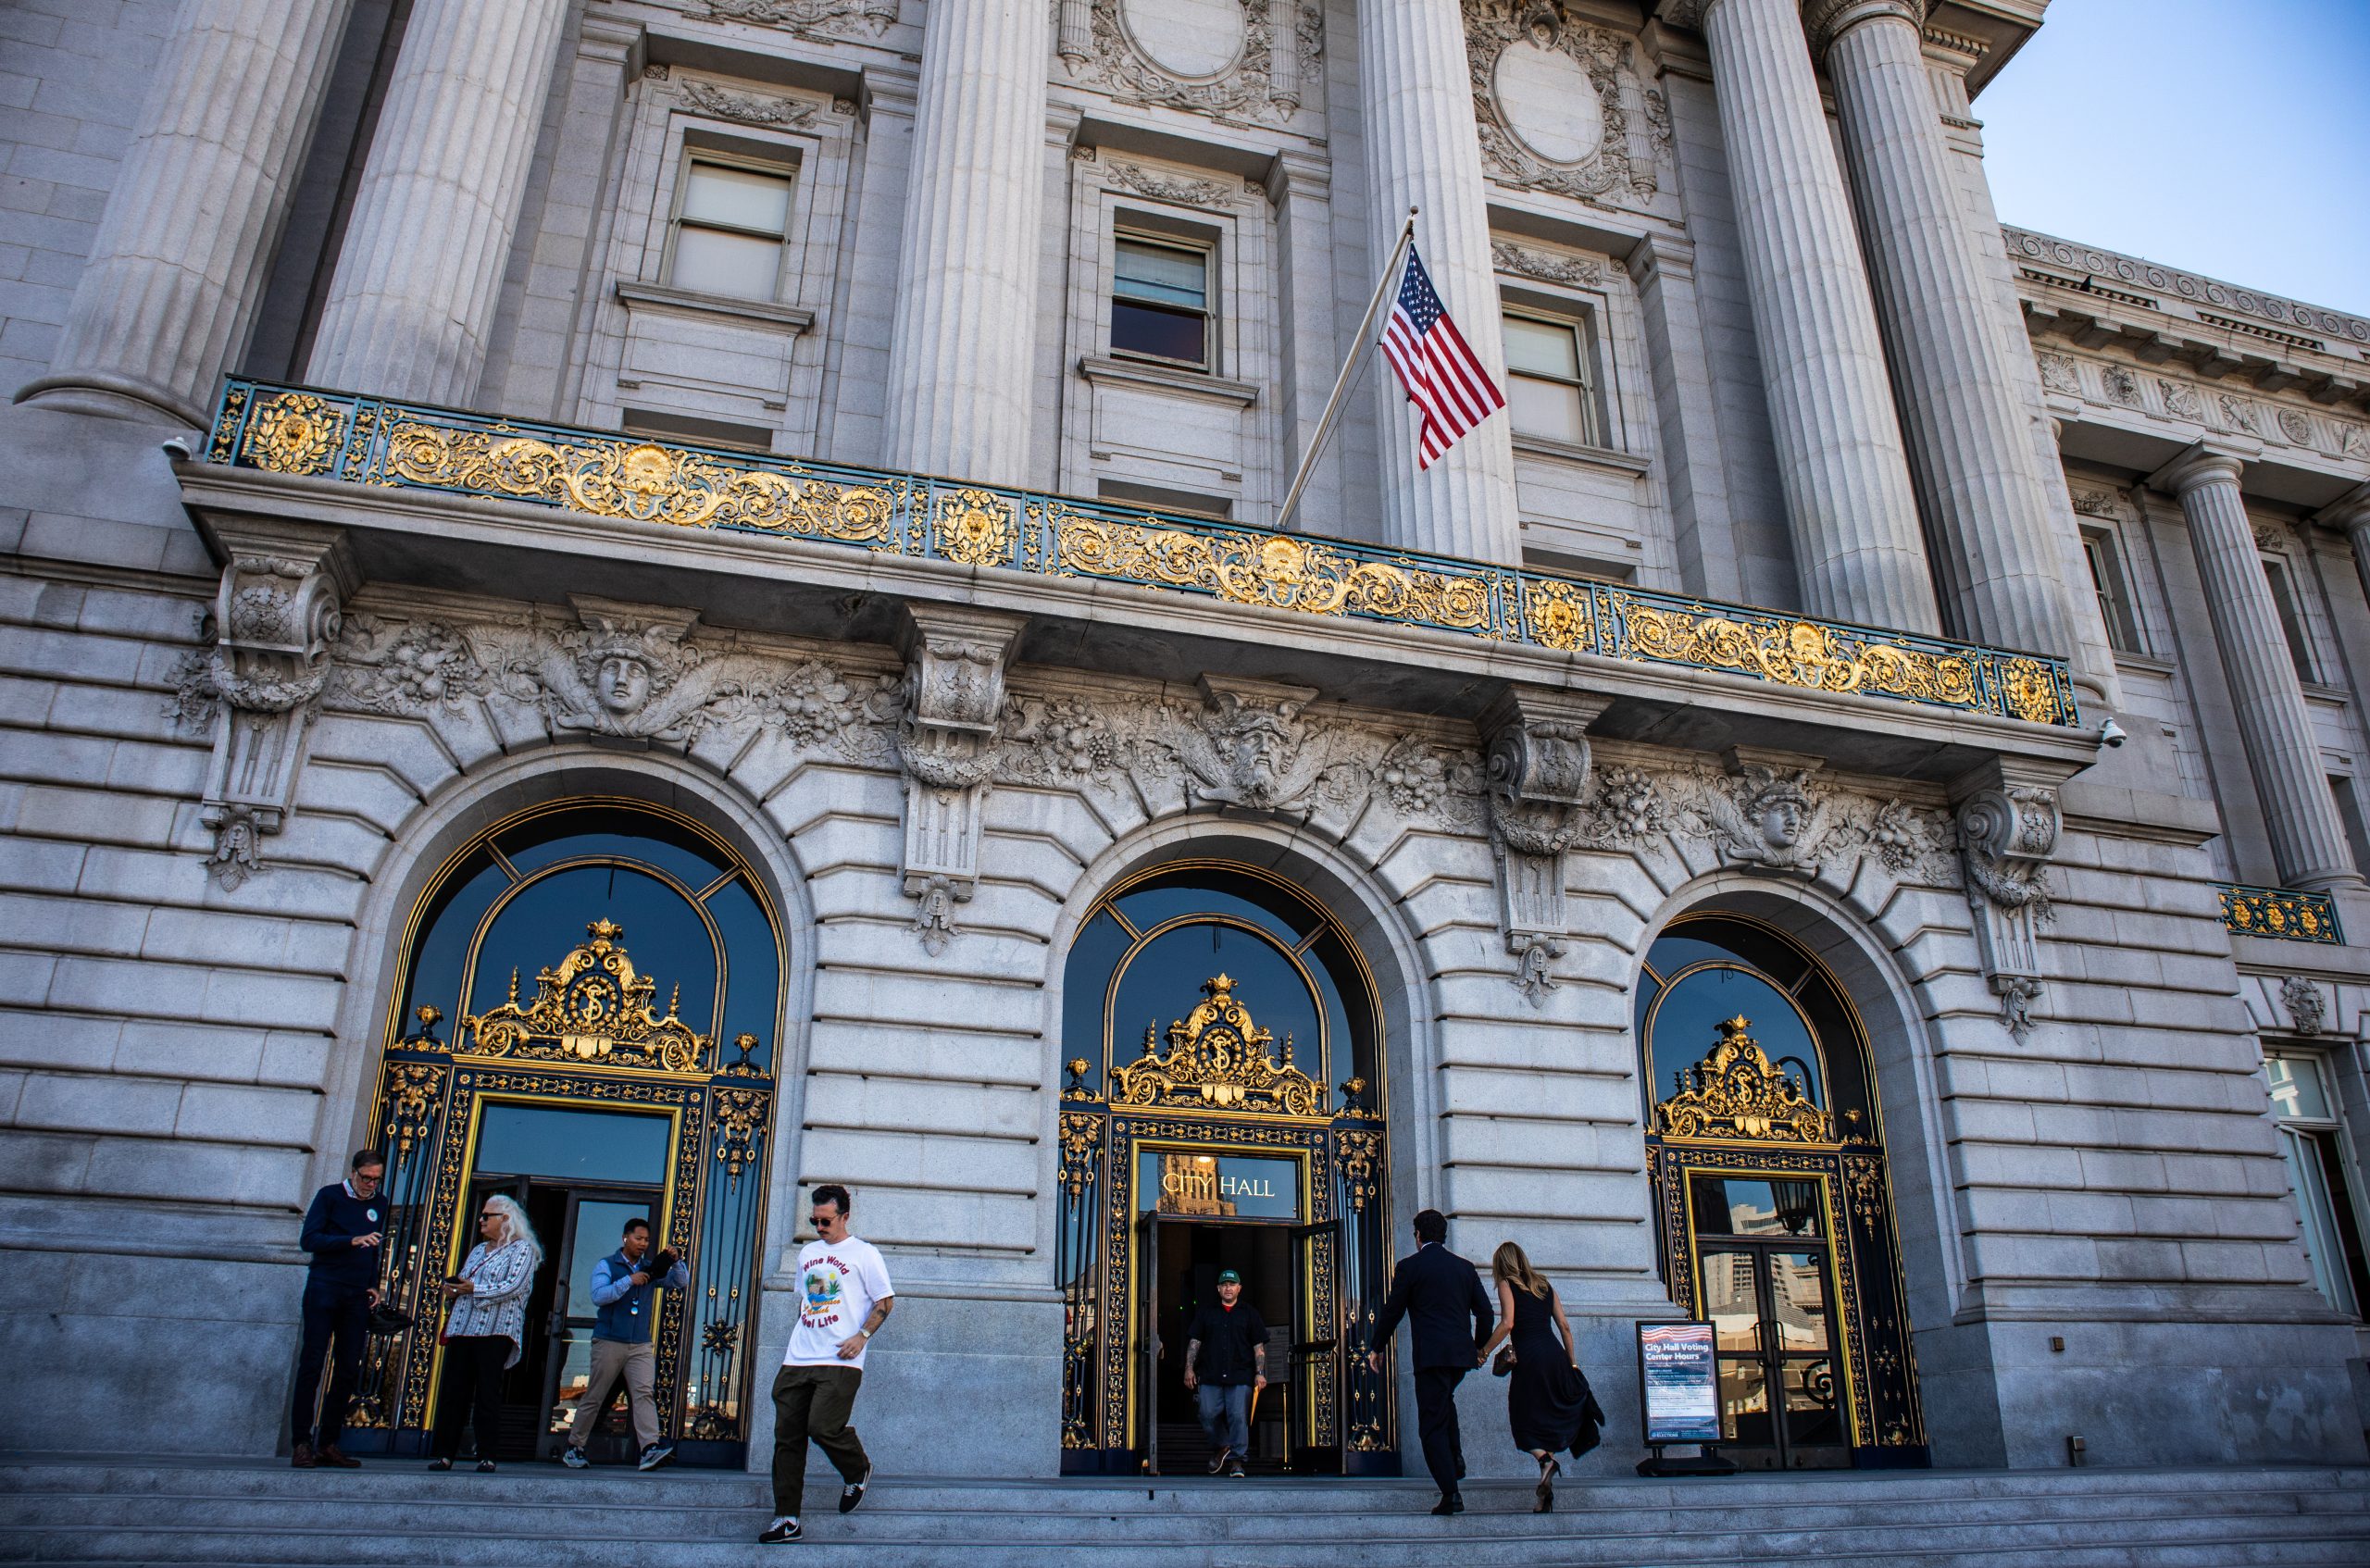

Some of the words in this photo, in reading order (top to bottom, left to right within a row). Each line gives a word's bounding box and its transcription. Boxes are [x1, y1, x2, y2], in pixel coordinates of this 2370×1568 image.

[1163, 1173, 1213, 1193] CITY
[1220, 1176, 1275, 1197] HALL
[804, 1257, 824, 1273] Wine
[826, 1255, 850, 1276] World
[1644, 1343, 1662, 1353] City
[1663, 1342, 1680, 1351] Hall
[1681, 1342, 1709, 1353] Voting
[1645, 1352, 1673, 1361] Center
[1674, 1352, 1700, 1361] Hours
